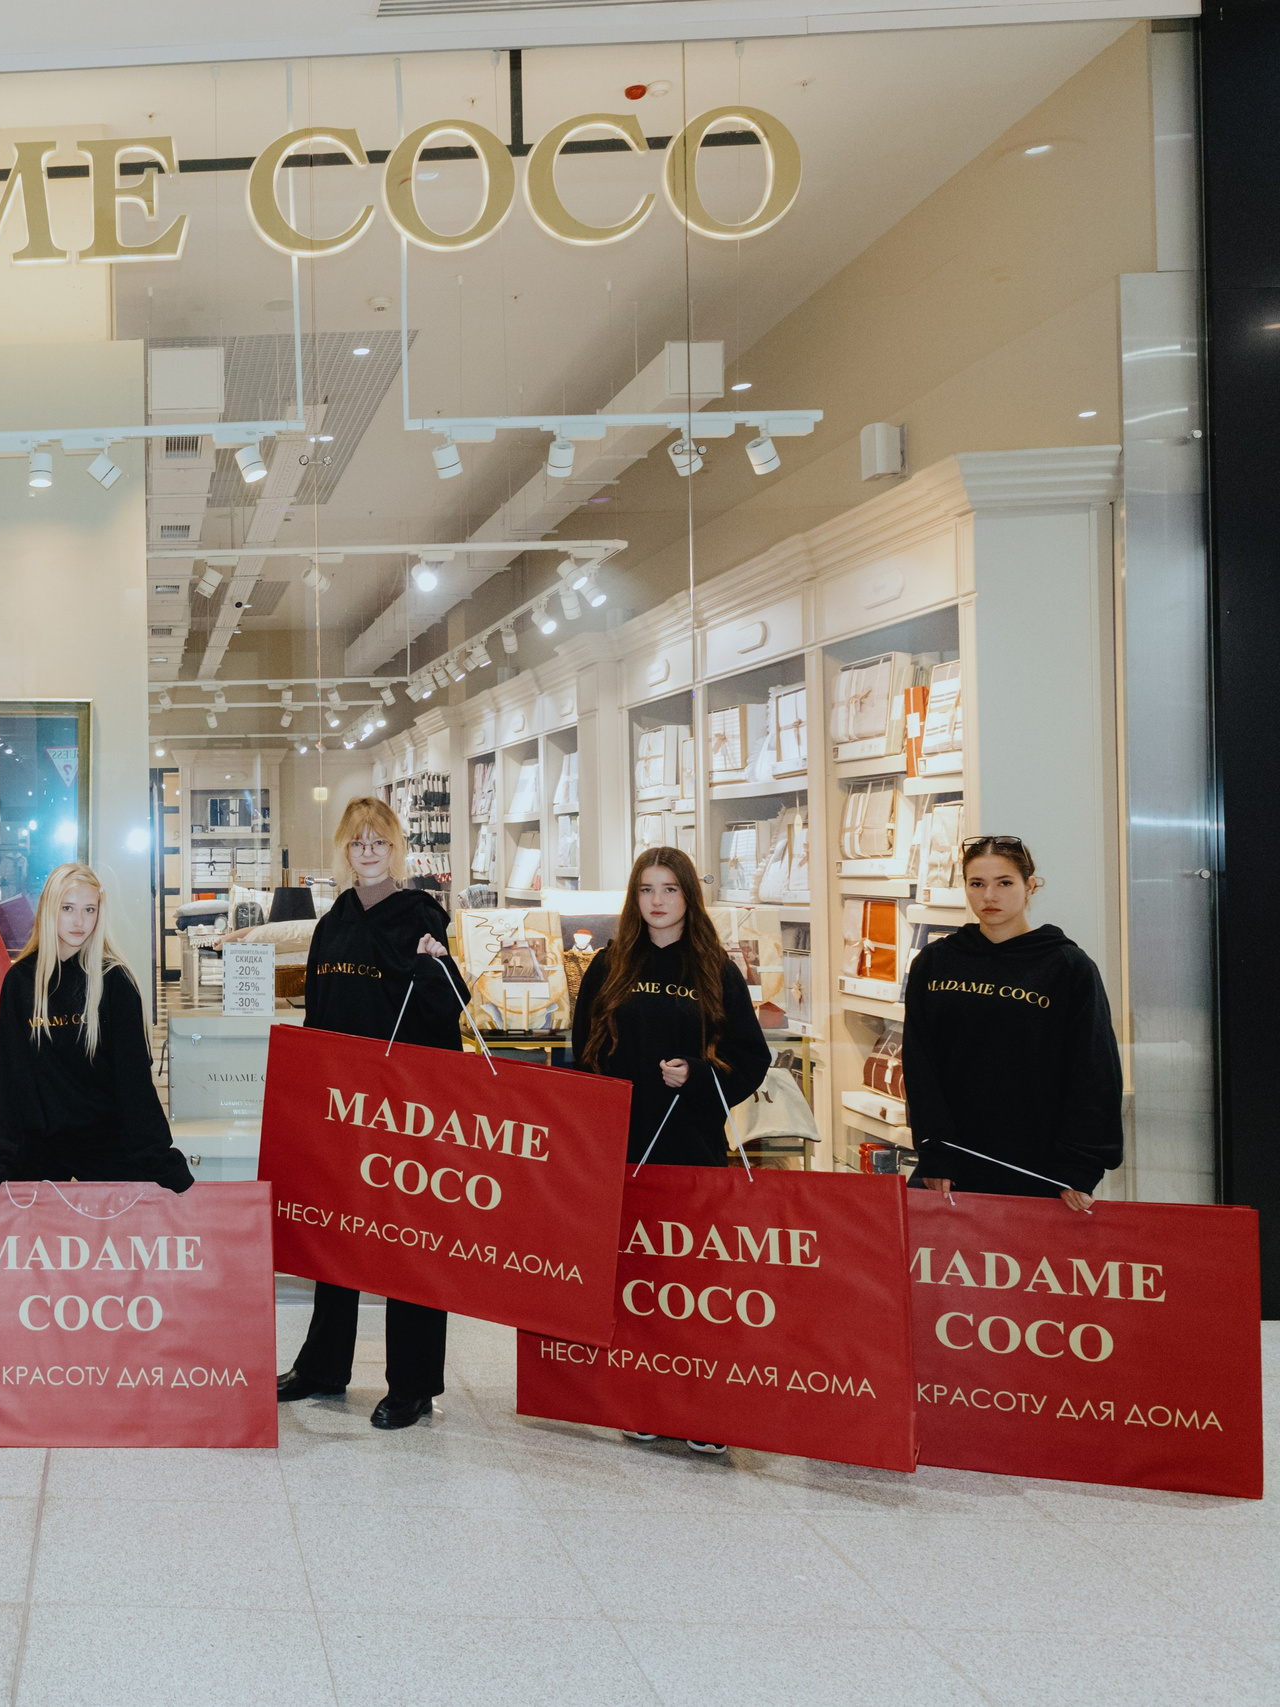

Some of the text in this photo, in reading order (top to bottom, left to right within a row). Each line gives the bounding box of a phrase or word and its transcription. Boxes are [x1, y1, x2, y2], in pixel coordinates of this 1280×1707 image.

[245, 104, 803, 259] COCO
[235, 955, 263, 963] СКИДКА
[235, 966, 260, 976] -20%
[235, 981, 260, 992] -25%
[235, 997, 260, 1007] -30%
[665, 983, 701, 1001] COC
[927, 980, 1050, 1009] MADAME COCO
[207, 1073, 258, 1082] MADAME
[325, 1088, 550, 1162] MADAME
[360, 1153, 502, 1210] COCO
[277, 1200, 584, 1285] НЕСУ КРАСОТУ ДЛЯ ДОМА
[619, 1220, 820, 1267] ADAME
[19, 1295, 162, 1331] COCO
[623, 1280, 775, 1327] COCO
[936, 1312, 1113, 1361] COCO
[3, 1366, 109, 1385] КРАСОТУ
[117, 1367, 163, 1388] ДЛЯ
[171, 1367, 247, 1388] ДОМА
[540, 1340, 877, 1399] НЕСУ КРАСОТУ ДЛЯ ДОМА
[917, 1382, 1222, 1431] КРАСОТУ ДЛЯ ДОМА
